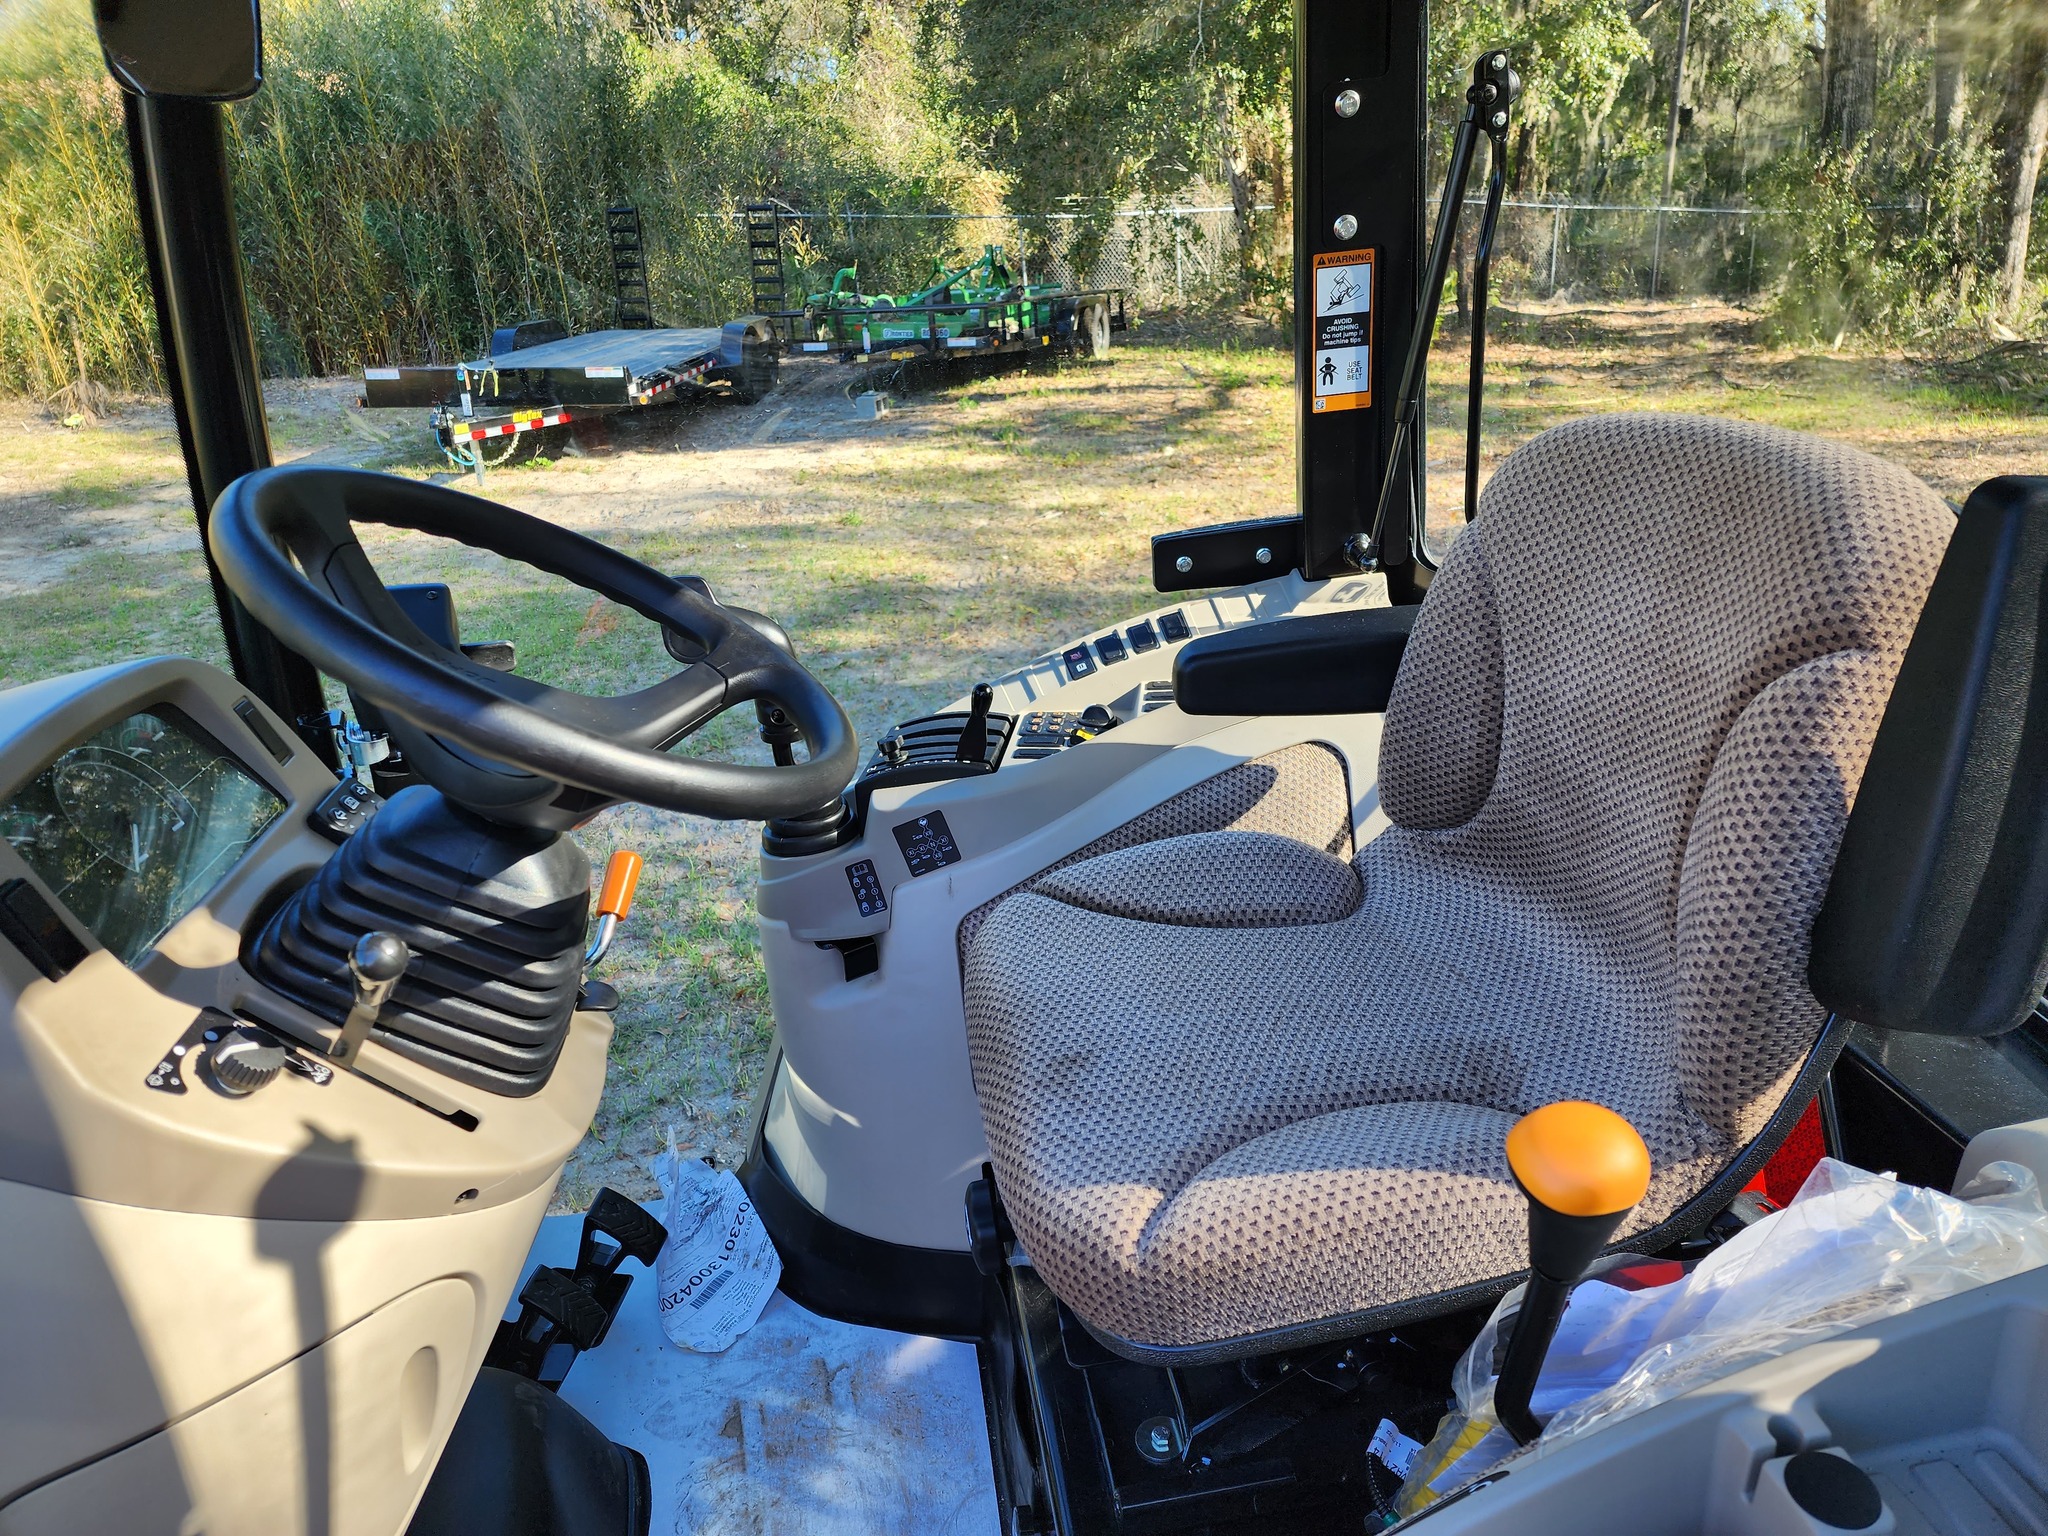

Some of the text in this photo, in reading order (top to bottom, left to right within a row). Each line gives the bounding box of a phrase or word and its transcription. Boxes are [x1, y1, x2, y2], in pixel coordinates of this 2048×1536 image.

[1327, 253, 1371, 265] WARNING
[1333, 317, 1353, 325] AVOID
[1326, 323, 1359, 333] CRUSHING
[1324, 338, 1349, 346] machine
[1346, 373, 1363, 381] BELT
